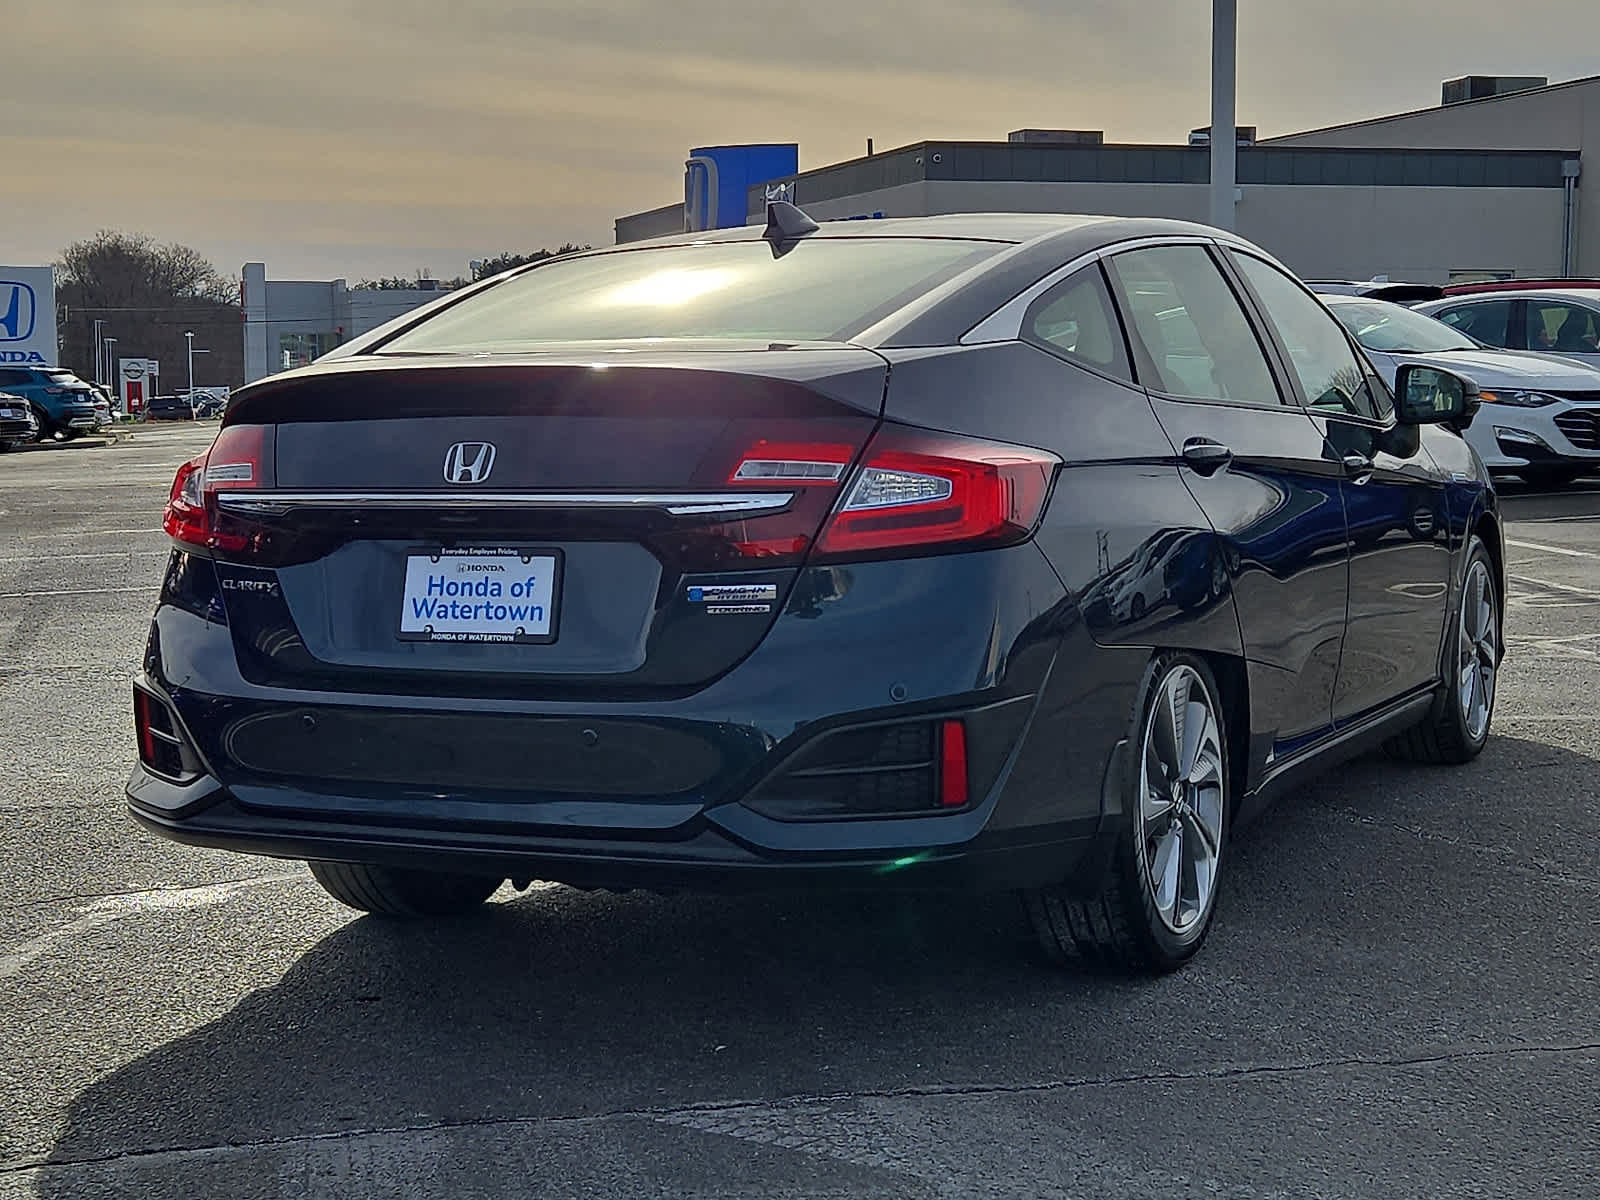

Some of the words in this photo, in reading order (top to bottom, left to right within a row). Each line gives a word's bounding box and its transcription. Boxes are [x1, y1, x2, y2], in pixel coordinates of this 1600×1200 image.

[0, 351, 46, 363] NDA
[467, 564, 505, 572] HONDA
[427, 575, 502, 597] Honda
[510, 576, 536, 598] of
[412, 598, 543, 621] Watertown
[431, 633, 457, 641] HONDA
[469, 634, 514, 642] WATERTOWN
